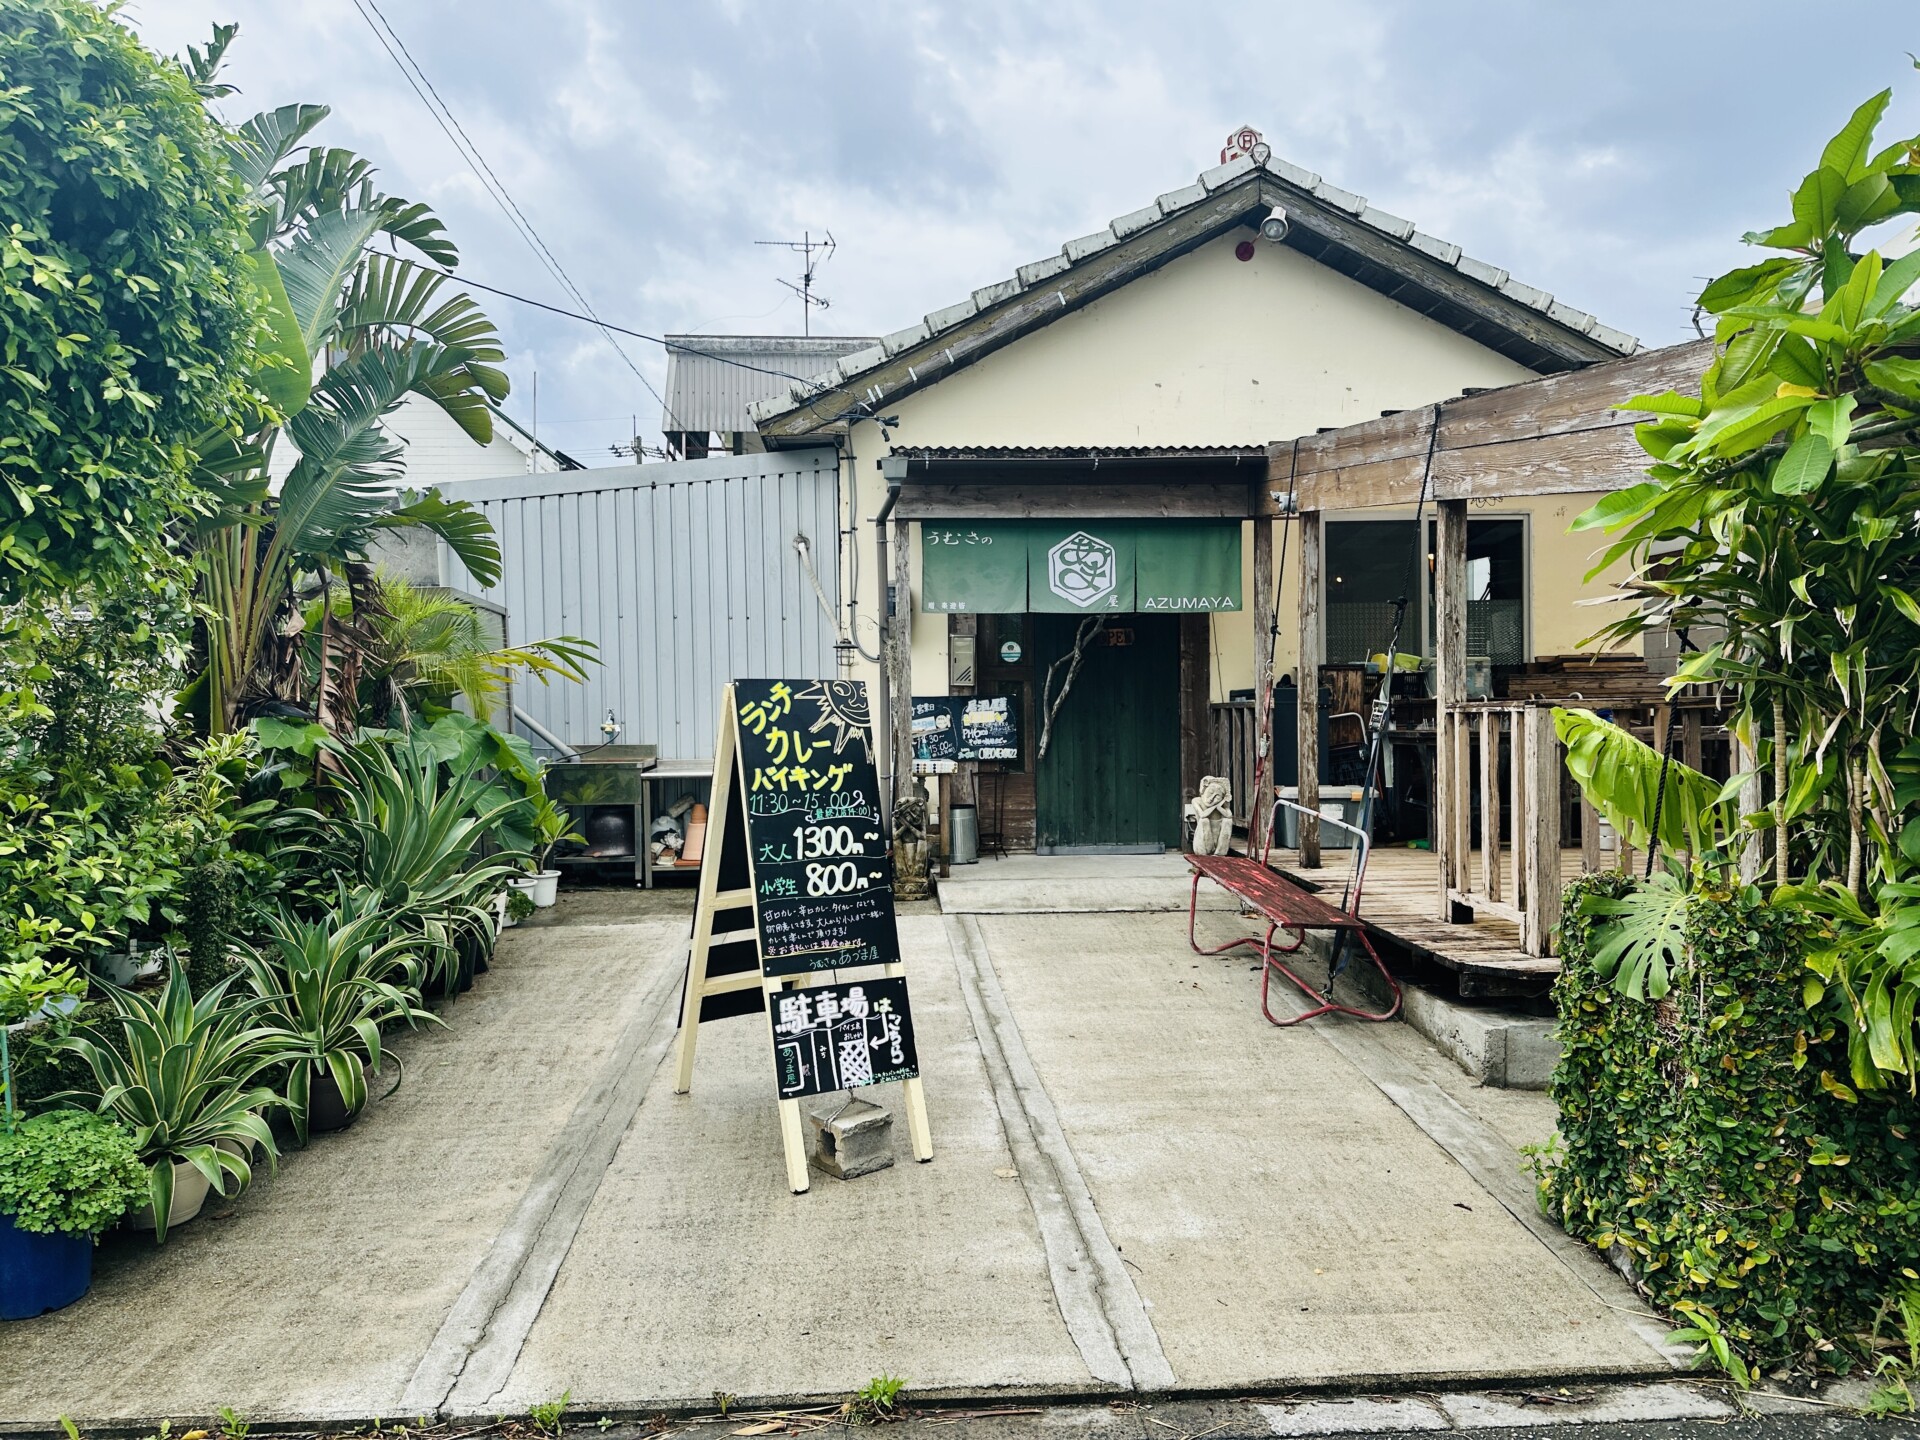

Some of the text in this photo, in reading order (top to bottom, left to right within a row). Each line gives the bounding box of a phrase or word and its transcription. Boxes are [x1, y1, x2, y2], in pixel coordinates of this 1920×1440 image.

[926, 530, 993, 546] うむさの
[1104, 594, 1119, 608] 屋
[1144, 596, 1235, 609] AZUMAYA
[739, 681, 792, 735] ランチ
[766, 726, 832, 765] カレー
[751, 763, 853, 793] バイキング
[759, 843, 792, 862] 大人
[760, 876, 799, 896] 小学生
[782, 1047, 797, 1085] あづま屋
